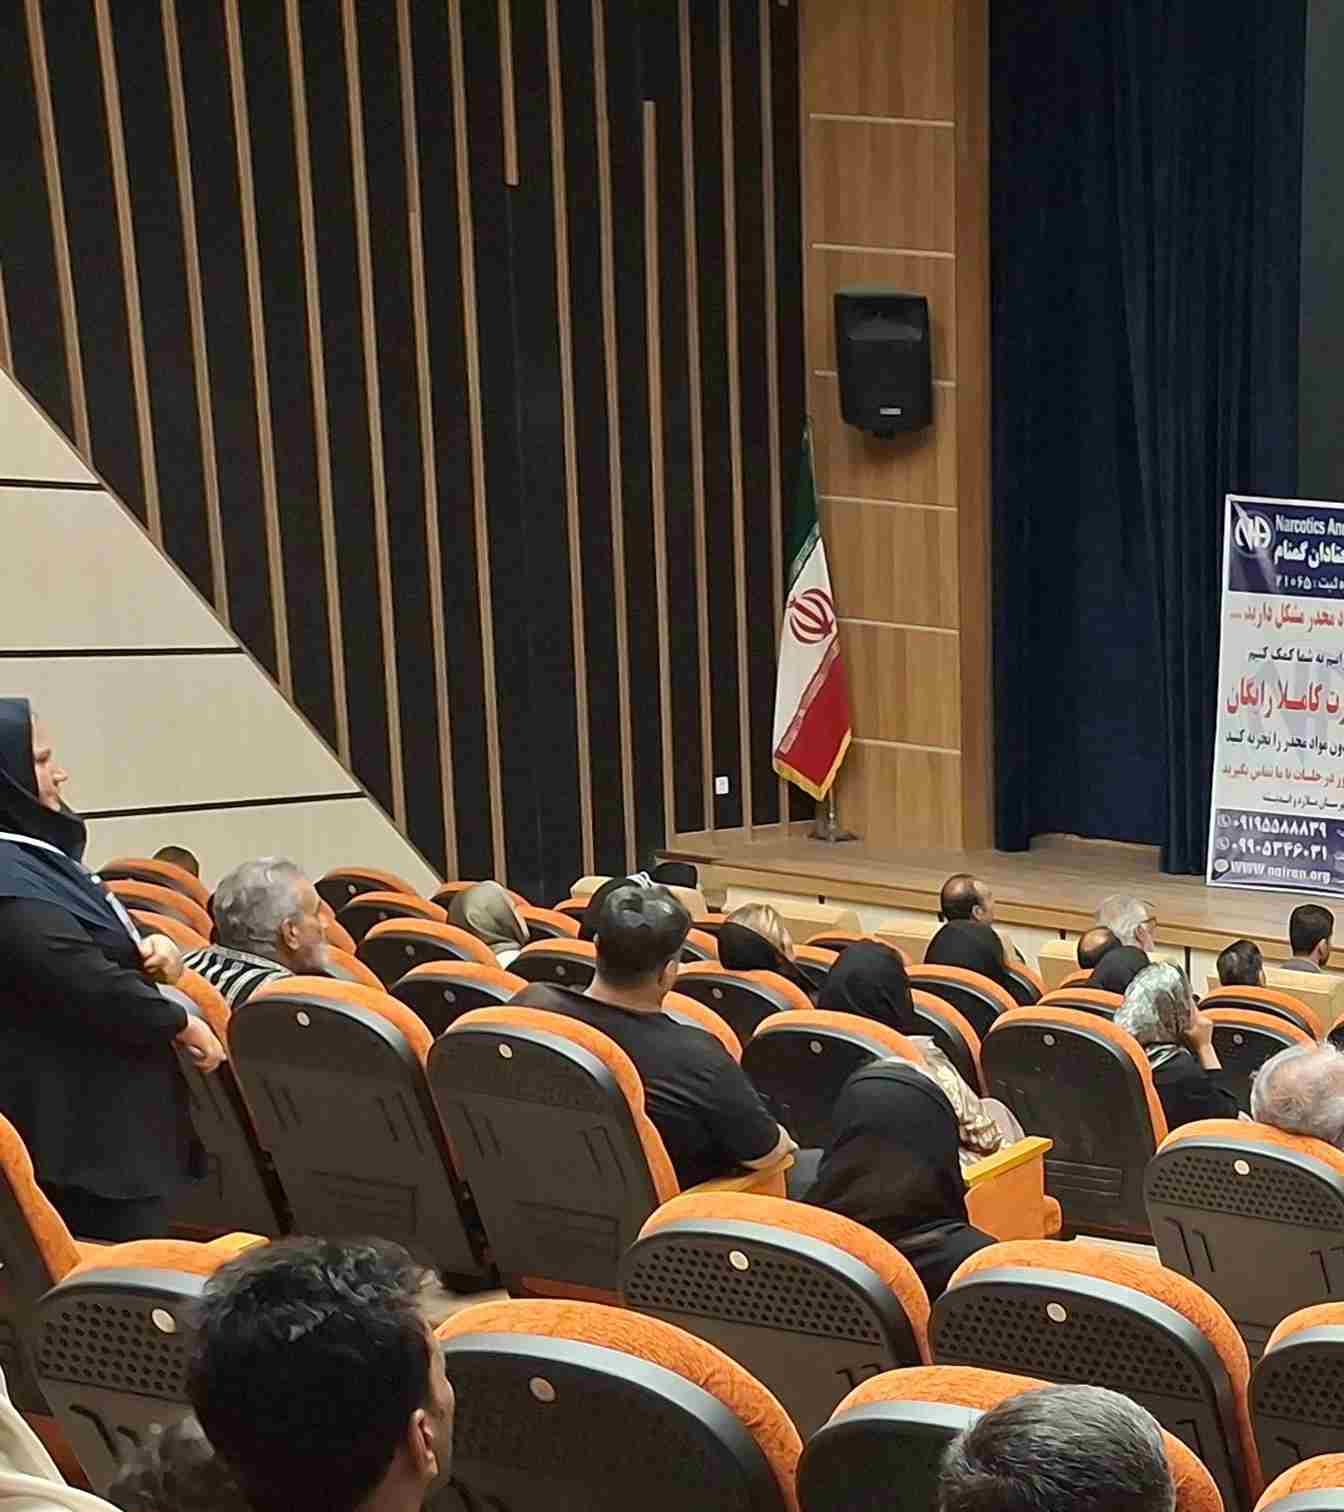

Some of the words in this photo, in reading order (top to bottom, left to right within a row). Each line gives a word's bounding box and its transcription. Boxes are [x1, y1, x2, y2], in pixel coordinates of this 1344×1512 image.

[1275, 514, 1326, 536] Narcotics
[1273, 539, 1309, 566] گمنام
[1232, 813, 1328, 839] ۰۹۱۹۵۵۸۸۸۳۹
